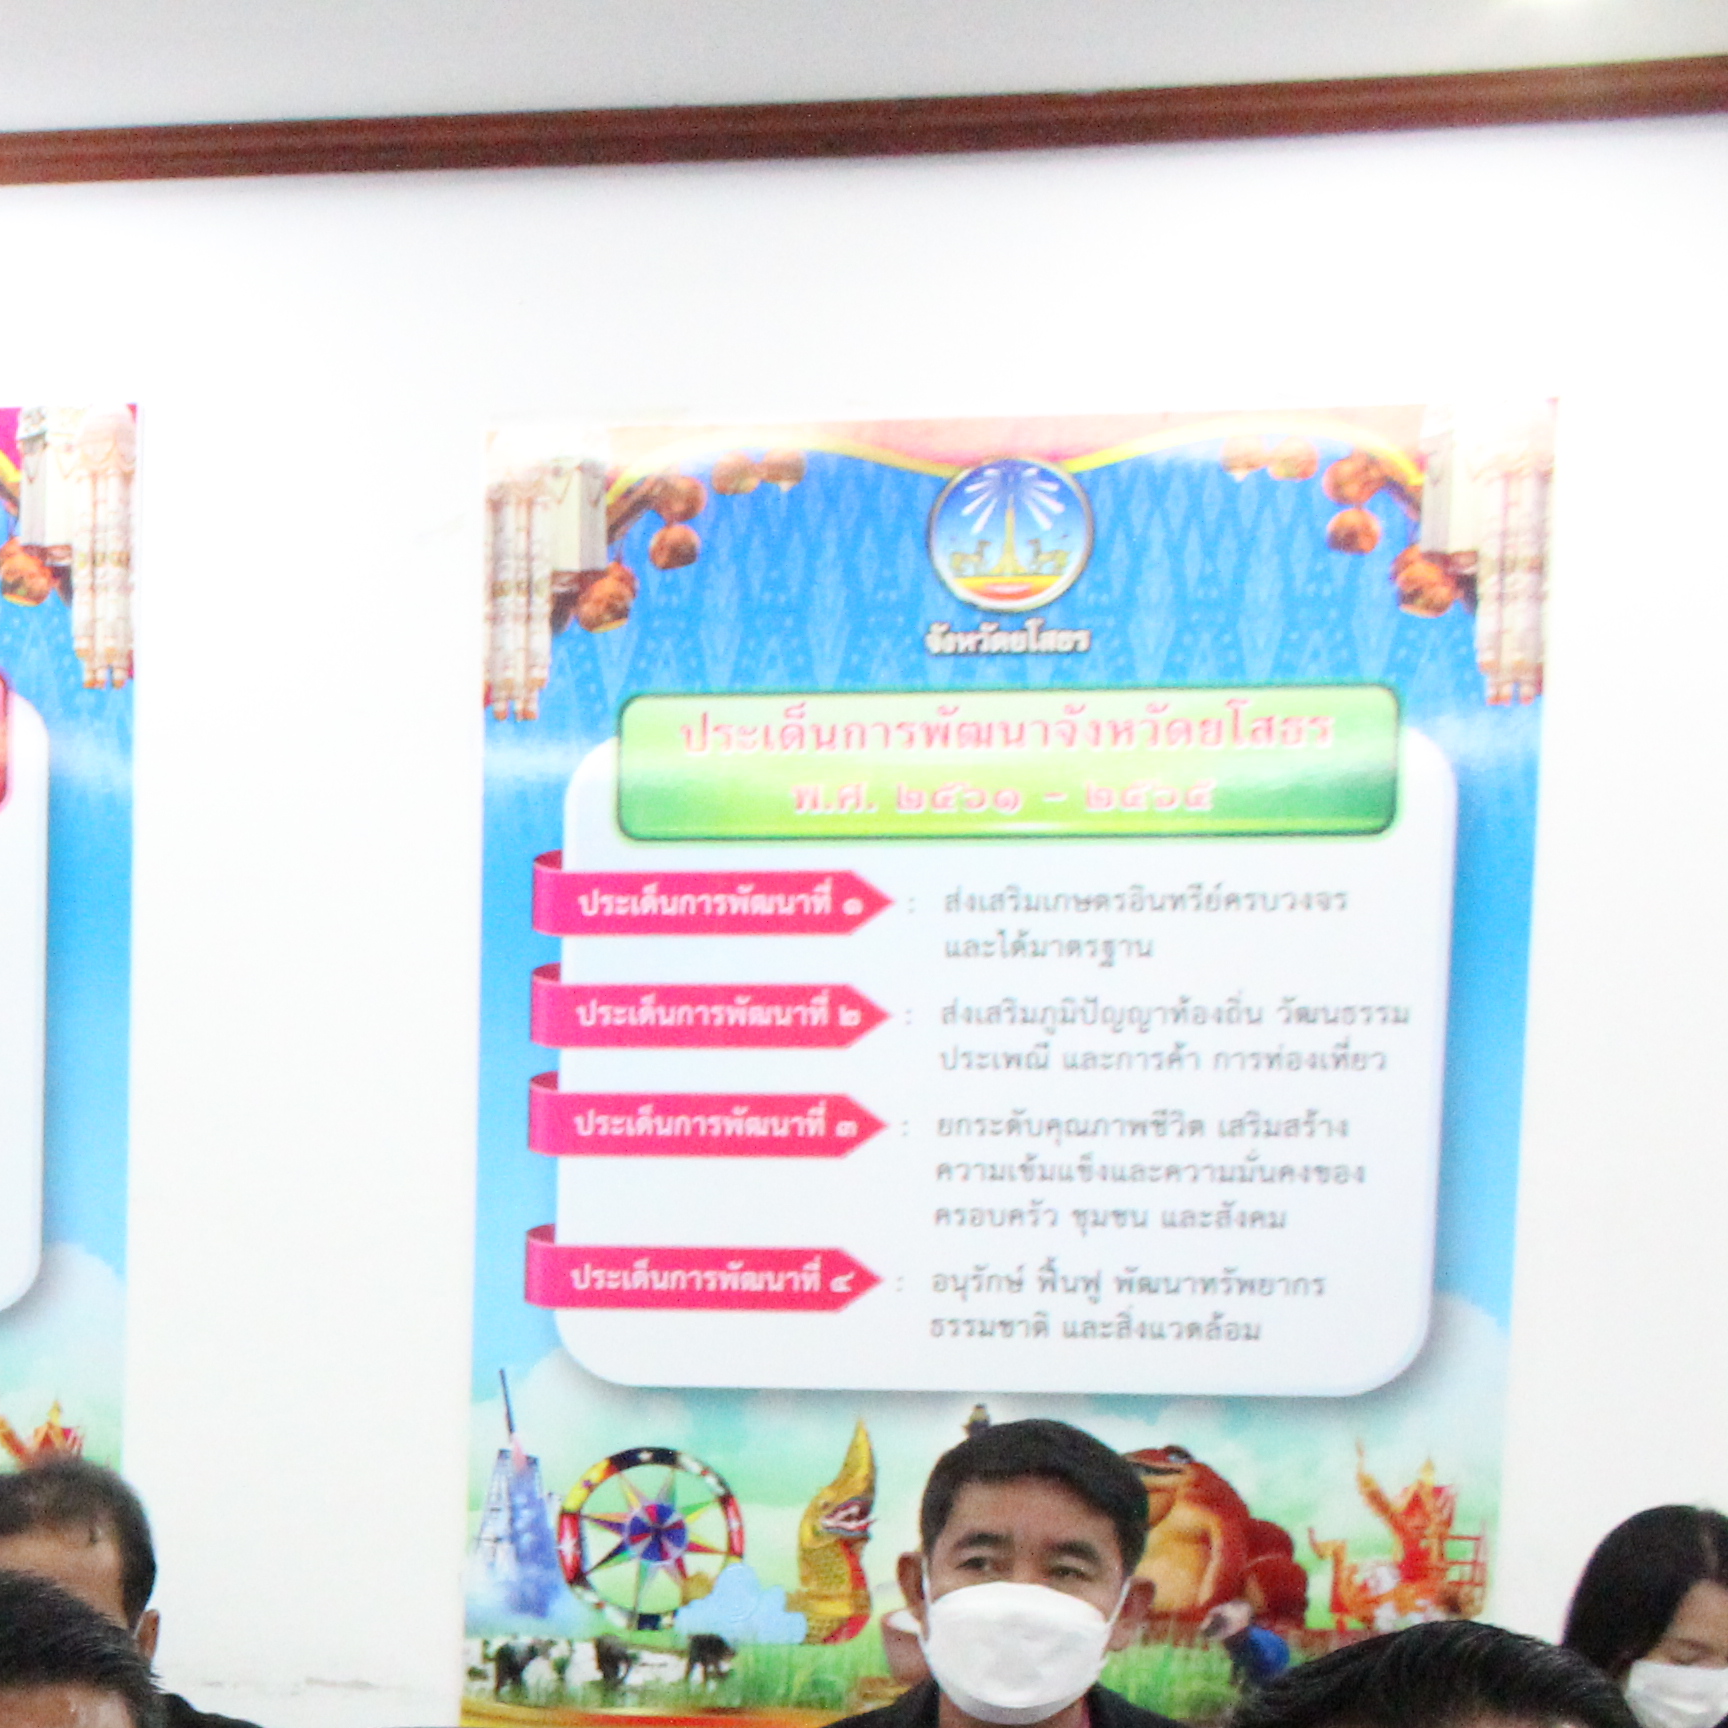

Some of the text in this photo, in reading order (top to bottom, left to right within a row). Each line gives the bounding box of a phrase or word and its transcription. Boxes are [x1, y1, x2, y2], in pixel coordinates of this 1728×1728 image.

[925, 617, 1090, 655] จังหวัดยโสธร
[681, 699, 1334, 754] ประเด็นการพัฒนาจังหวัดยโสธร
[792, 784, 877, 813] พ.ศ.
[578, 877, 833, 916] ประเด็นการพัฒนาที่
[944, 882, 1348, 914] ส่งเสริมเกษตรอินทรีย์ครบวงจร
[944, 929, 1153, 967] และได้มาตรฐาน
[575, 989, 829, 1027] ประเด็นการพัฒนาที่
[942, 990, 1262, 1036] ส่งเสริมภูมิปัญญาท้องถิ่น
[1276, 1001, 1410, 1027] วัฒนธรรม
[941, 1036, 1387, 1072] ประเพณี และการค้า การท่องเที่ยว
[574, 1100, 827, 1137] ประเด็นการพัฒนาที่
[936, 1108, 1205, 1146] ยกระดับคุณภาพชีวิต
[1219, 1108, 1350, 1139] เสริมสร้าง
[934, 1148, 1366, 1185] ความเข้มแข็งและความมั่นคงของ
[933, 1197, 1287, 1237] ครอบครัว ชุมชน และสังคม
[570, 1254, 821, 1292] ประเด็นการพัฒนาที่
[931, 1264, 1026, 1302] อนุรักษ์
[1037, 1254, 1102, 1304] ฟื้นฟู
[1115, 1266, 1327, 1297] พัฒนาทรัพยากร
[930, 1304, 1261, 1343] ธรรมชาติ และสิ่งแวดล้อม
